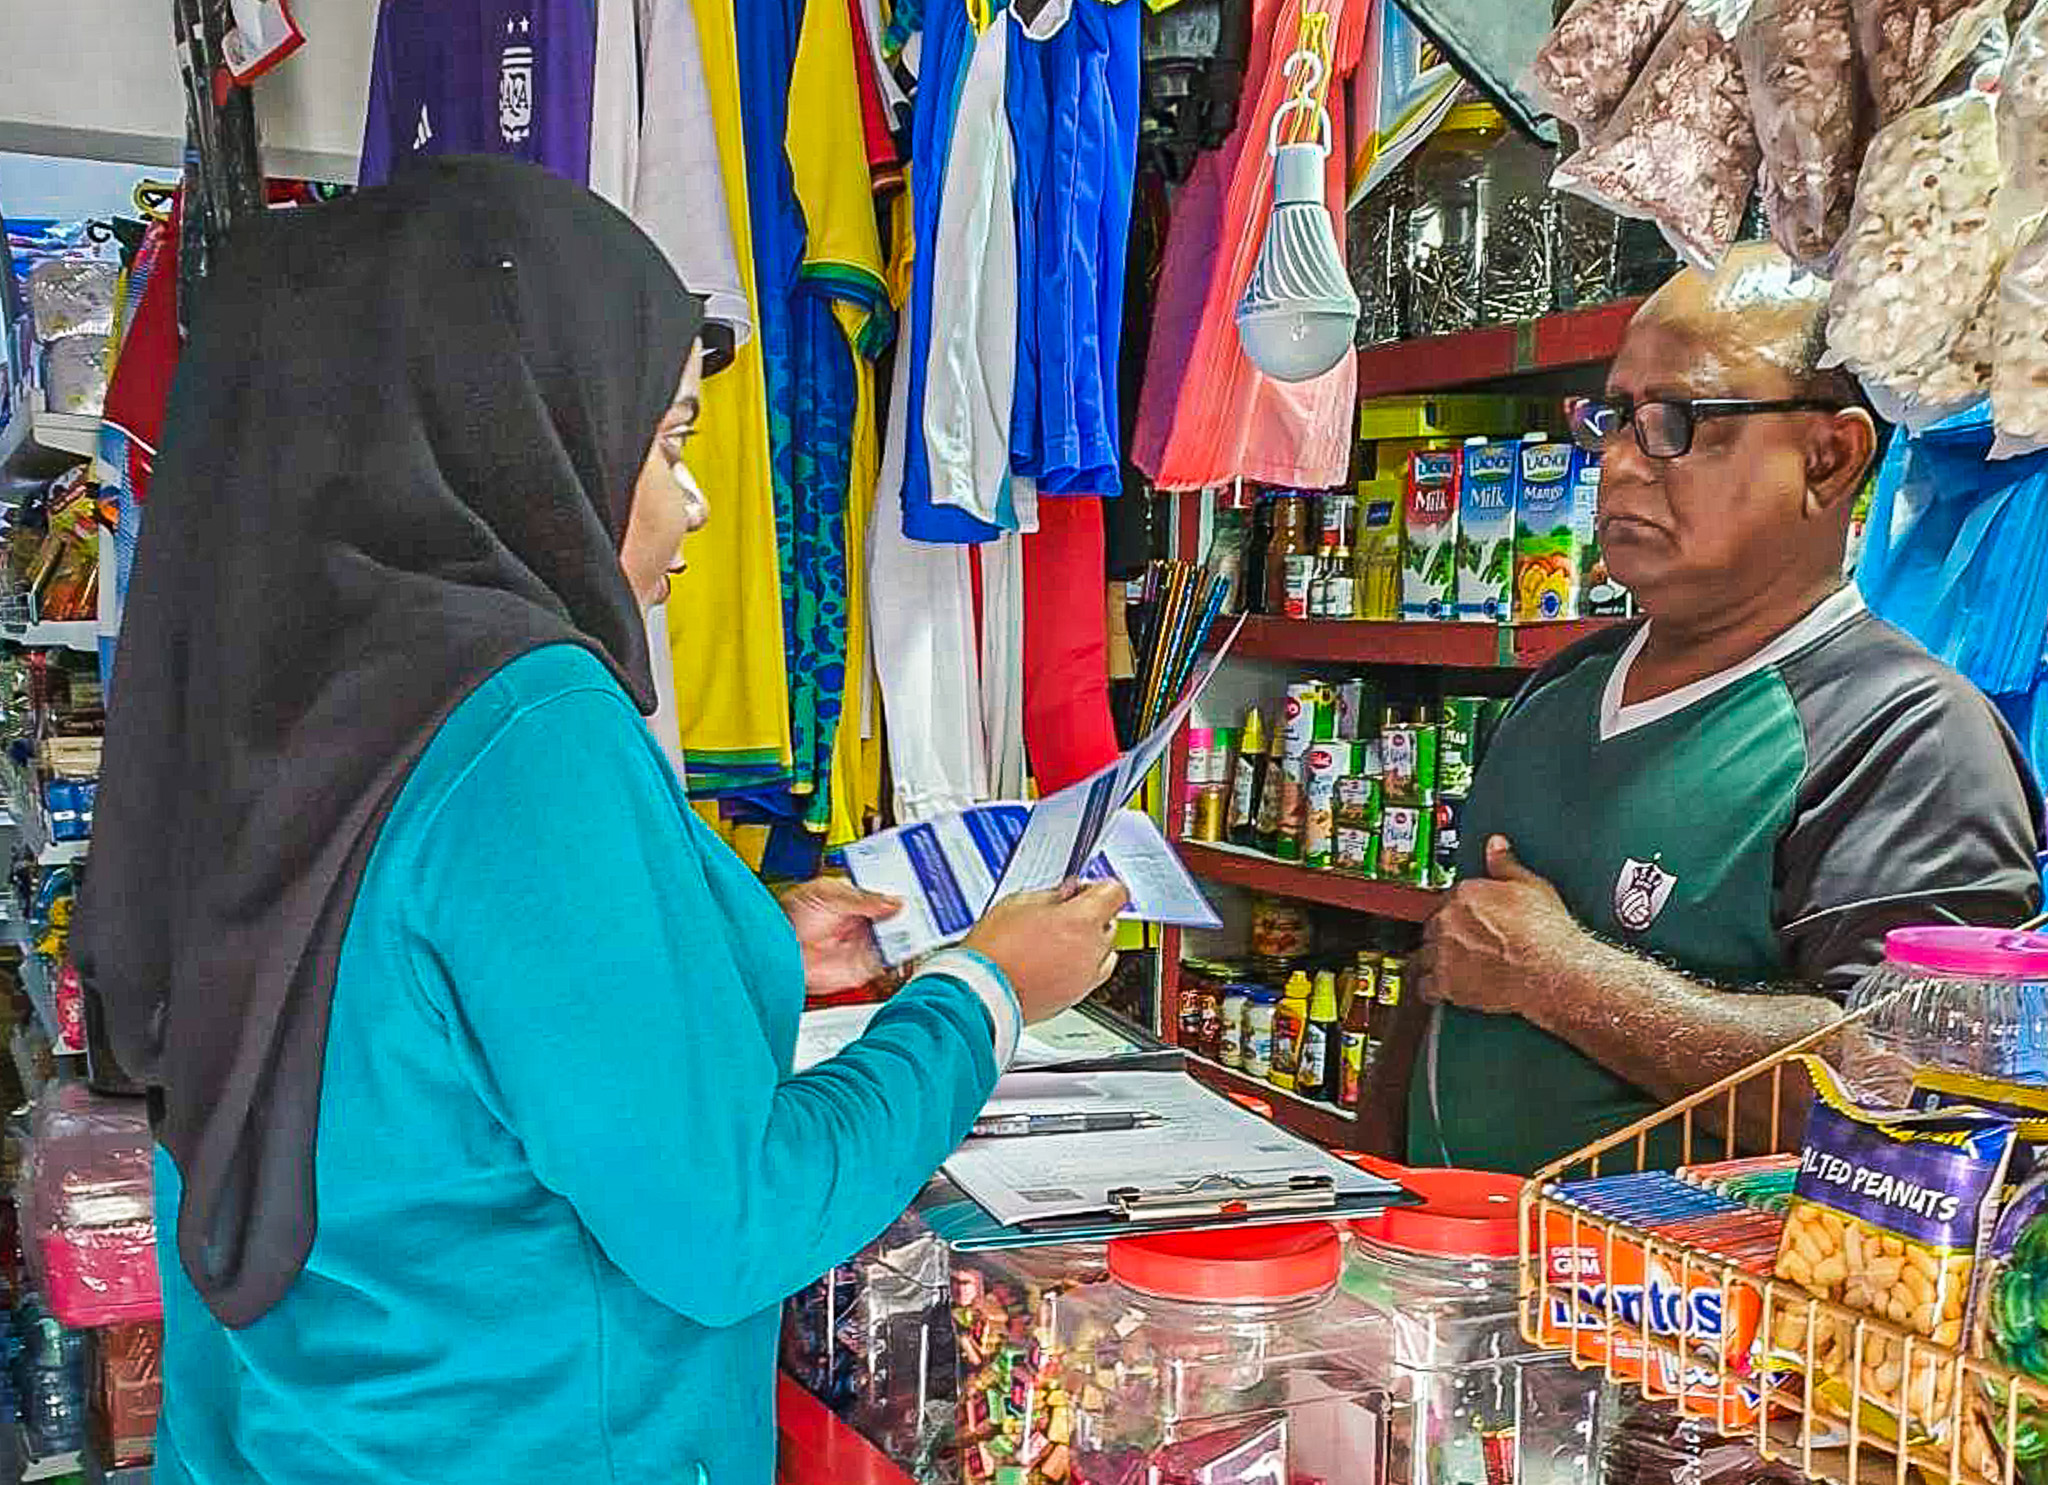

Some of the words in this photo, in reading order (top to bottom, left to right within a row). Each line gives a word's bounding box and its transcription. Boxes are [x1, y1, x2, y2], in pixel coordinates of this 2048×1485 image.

[1413, 489, 1449, 511] Milk
[1470, 485, 1506, 507] Milk
[1524, 486, 1564, 501] Mango
[1801, 1146, 1852, 1184] ALTED
[1851, 1166, 1960, 1221] PEANUTS
